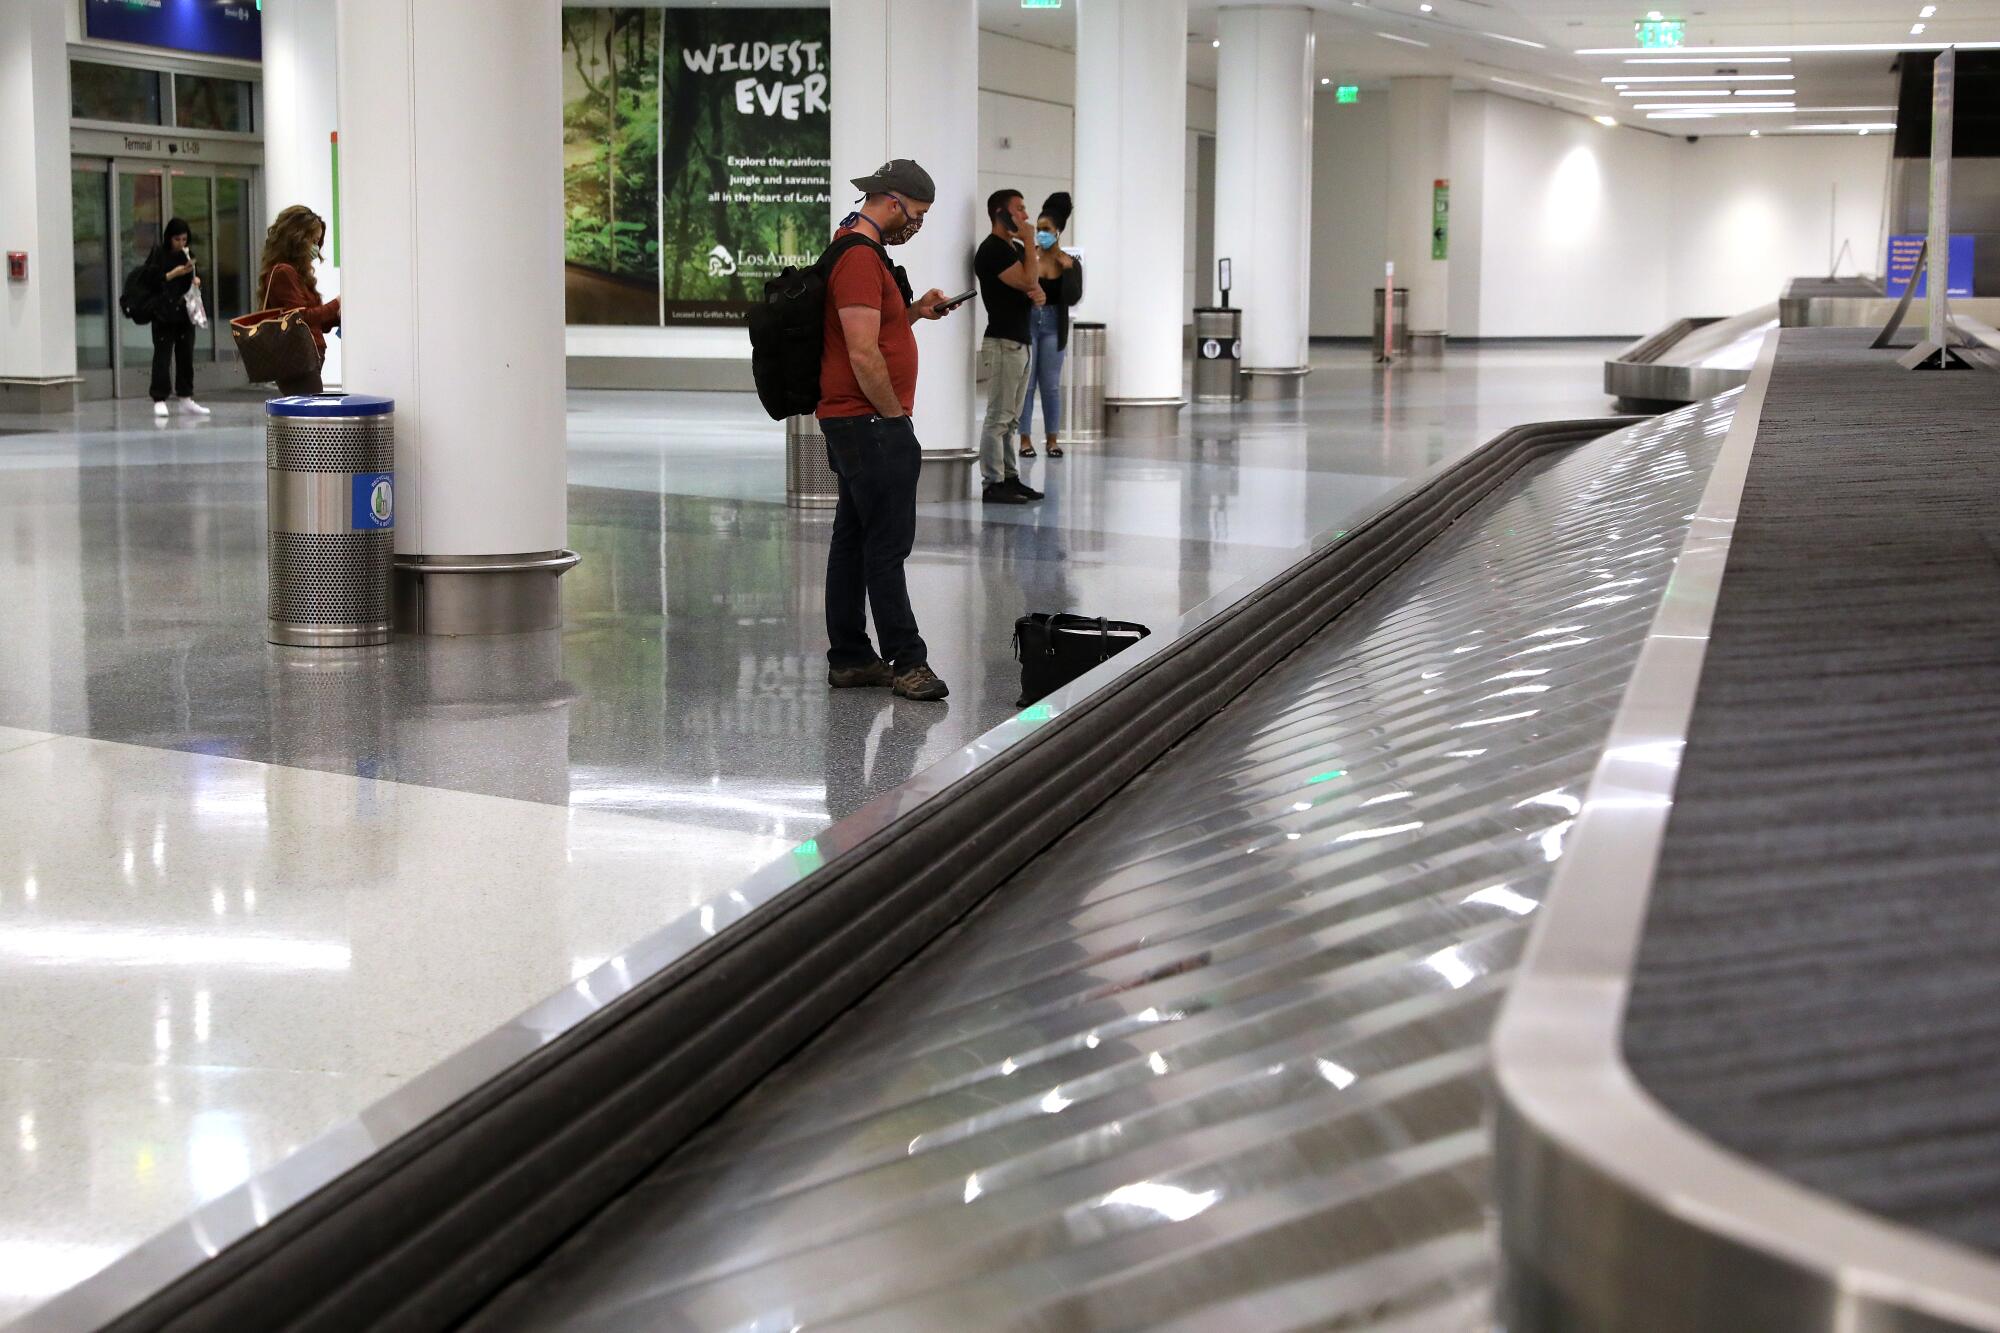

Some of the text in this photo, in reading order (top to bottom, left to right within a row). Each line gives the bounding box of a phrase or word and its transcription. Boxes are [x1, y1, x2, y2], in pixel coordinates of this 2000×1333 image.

[683, 40, 824, 76] WILDEST.
[735, 73, 831, 121] EVER.
[124, 136, 152, 152] Terminal
[157, 140, 161, 152] 1
[727, 155, 830, 168] Explore the rainfores
[730, 174, 761, 188] jungle
[763, 174, 782, 185] and
[708, 192, 720, 202] all
[722, 192, 732, 202] in
[734, 192, 752, 202] the
[753, 192, 782, 202] heart
[783, 192, 795, 203] of
[796, 193, 814, 203] Los
[737, 250, 819, 268] Los Angele
[672, 311, 696, 319] Located
[703, 311, 724, 320] Griffith
